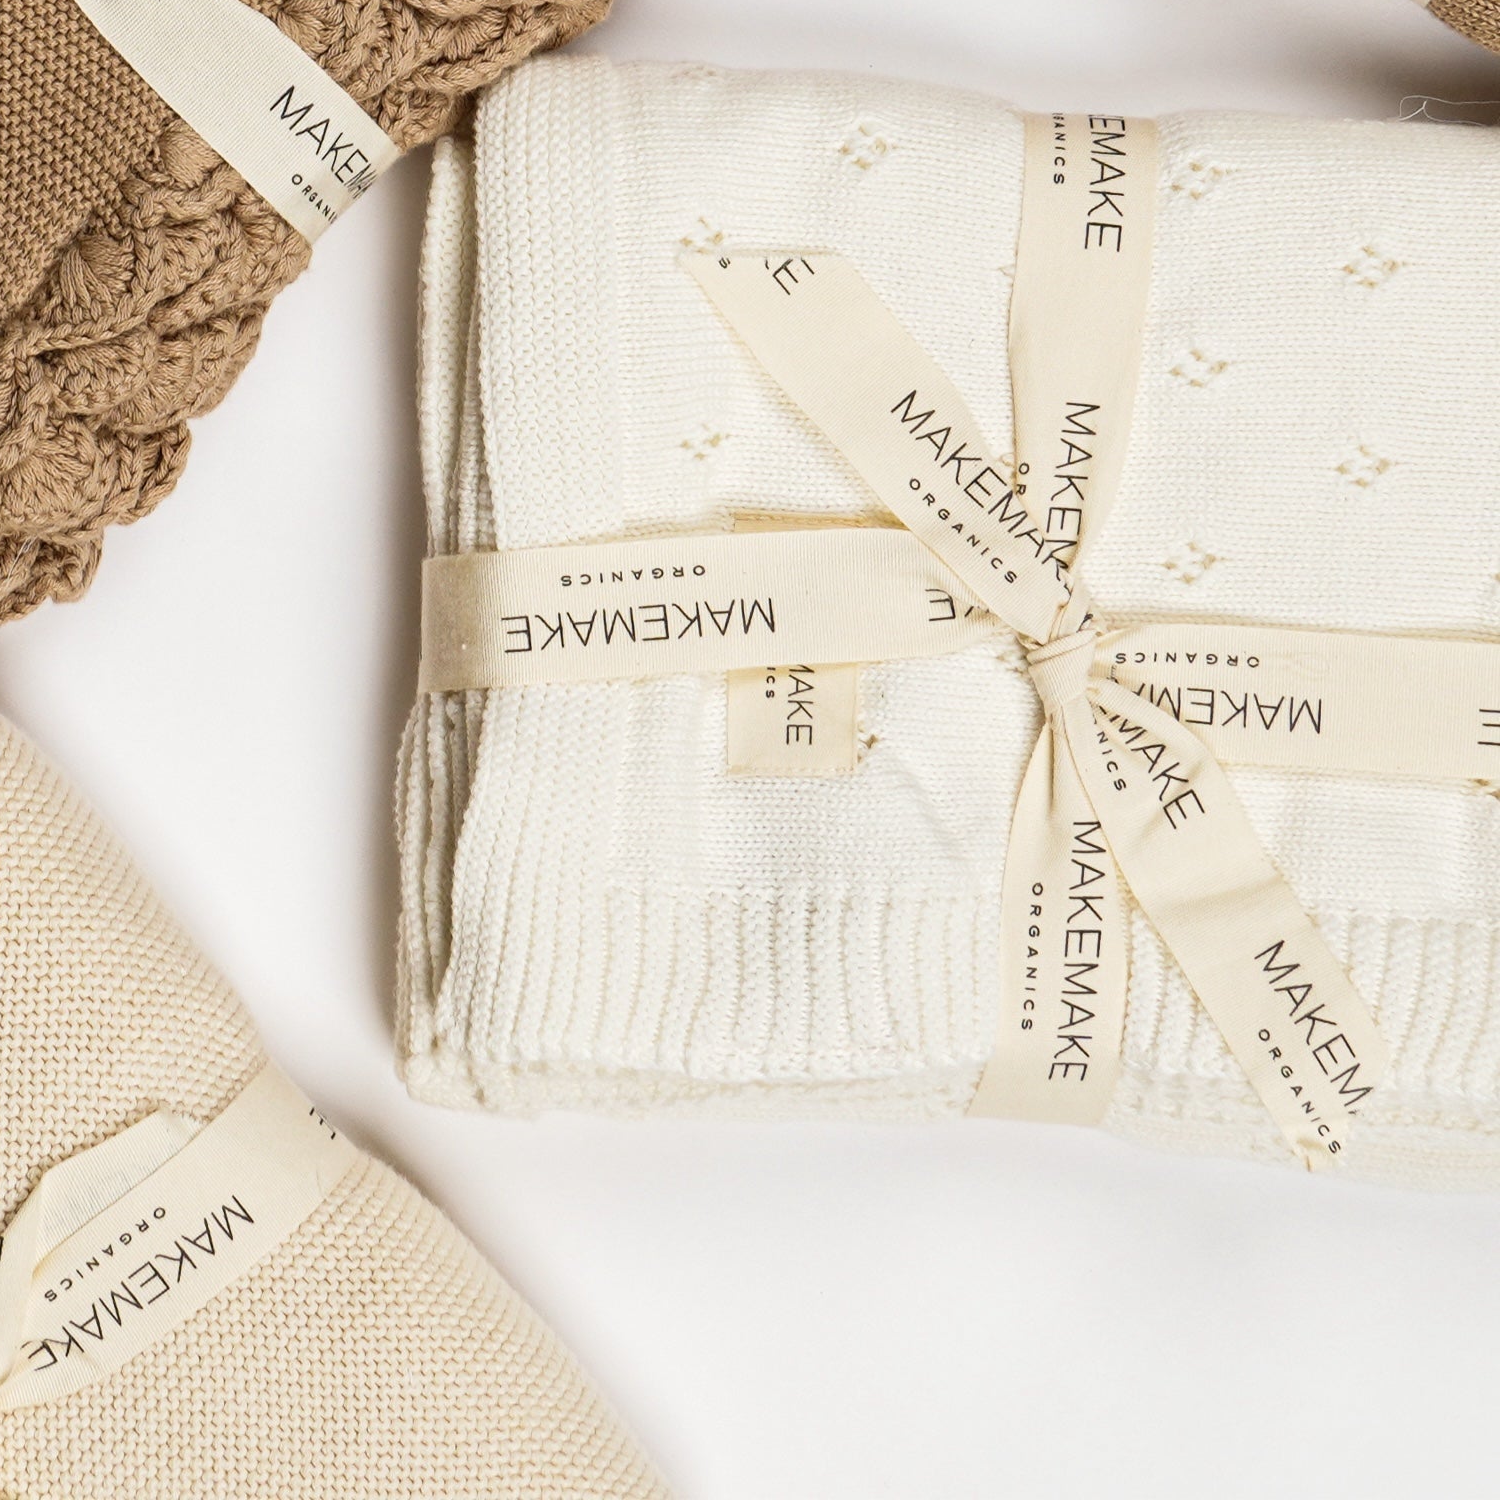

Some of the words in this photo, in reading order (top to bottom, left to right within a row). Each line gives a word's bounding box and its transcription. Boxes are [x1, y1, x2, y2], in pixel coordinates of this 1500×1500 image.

[560, 564, 706, 587] ORGANICS
[909, 478, 1018, 583] ORGANICS
[501, 598, 775, 653] MAKEMAKE
[1116, 652, 1260, 668] ORGANICS
[1021, 882, 1043, 1031] ORGANICS
[1048, 821, 1107, 1082] MAKEMAKE
[1254, 940, 1374, 1117] MAKEM
[1258, 1028, 1341, 1154] ORGANICS
[20, 1195, 254, 1372] MAKEMAKE
[44, 1207, 166, 1302] ORGANICS
